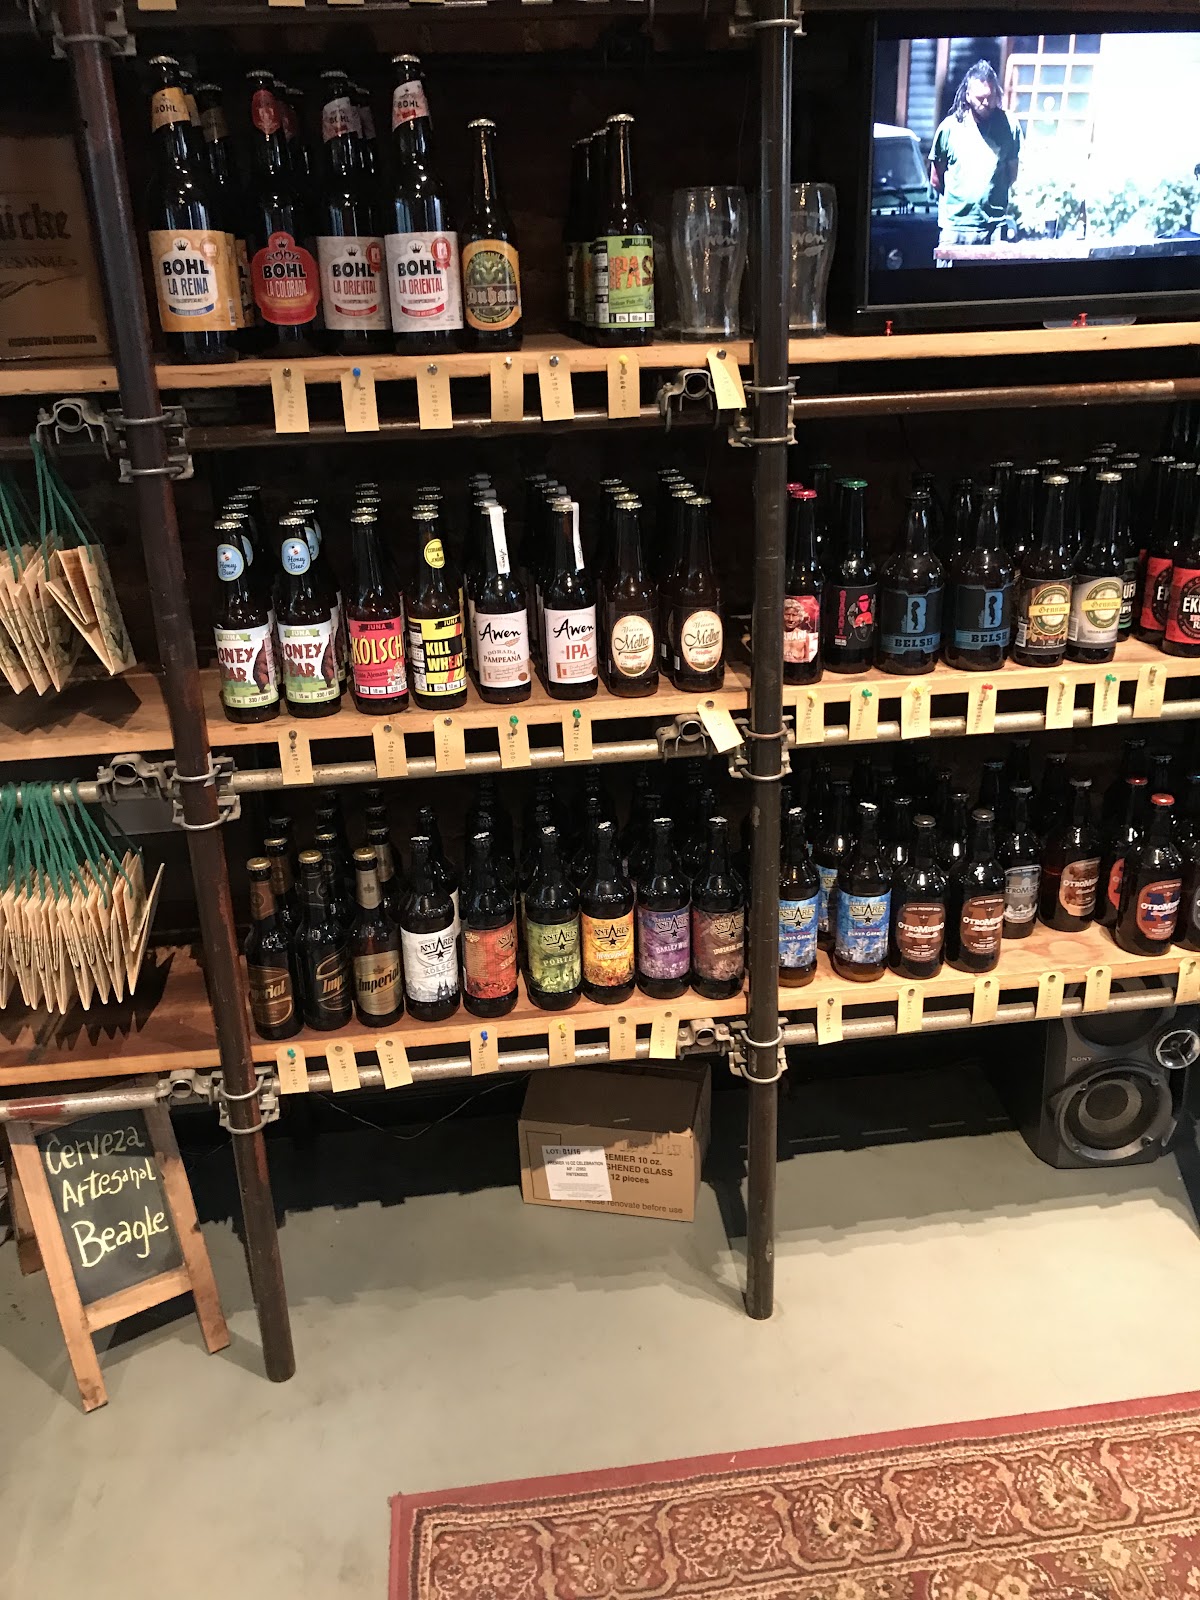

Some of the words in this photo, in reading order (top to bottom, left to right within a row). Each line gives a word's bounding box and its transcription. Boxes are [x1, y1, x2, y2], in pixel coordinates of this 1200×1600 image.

[398, 100, 420, 109] BOHL
[162, 258, 209, 276] BOHL
[263, 262, 307, 278] BOHL
[332, 262, 375, 278] BOHL
[398, 259, 442, 277] BOHL
[168, 279, 179, 296] LA
[181, 277, 209, 296] REINA
[266, 281, 274, 297] LA
[275, 280, 307, 298] COLORADA
[332, 280, 342, 293] LA
[343, 280, 378, 295] ORIENTAL
[399, 280, 407, 294] LA
[408, 278, 444, 294] ORIENTAL
[219, 561, 238, 572] Honey
[287, 555, 306, 565] Honey
[221, 568, 236, 577] Beer
[479, 622, 522, 645] Awen
[552, 618, 595, 641] Awen
[352, 634, 404, 666] KÖLSCH
[426, 641, 452, 657] KILL
[894, 637, 933, 648] BELSH
[217, 646, 255, 665] ONEY
[483, 653, 522, 664] PAMPEANA
[566, 643, 590, 660] IPA
[427, 654, 464, 672] WHEAT
[594, 924, 630, 939] ANTARES
[420, 935, 455, 953] ANTARES
[359, 962, 400, 994] Imperial
[45, 1126, 146, 1176] Cerveza
[638, 1156, 648, 1165] 10
[649, 1158, 662, 1166] oz.
[611, 1173, 621, 1181] 12
[622, 1174, 650, 1185] pieces
[643, 1167, 674, 1177] GLASS
[62, 1157, 157, 1214] Artesanal
[607, 1199, 641, 1209] renovate
[642, 1202, 667, 1213] before
[71, 1205, 169, 1268] Beagle
